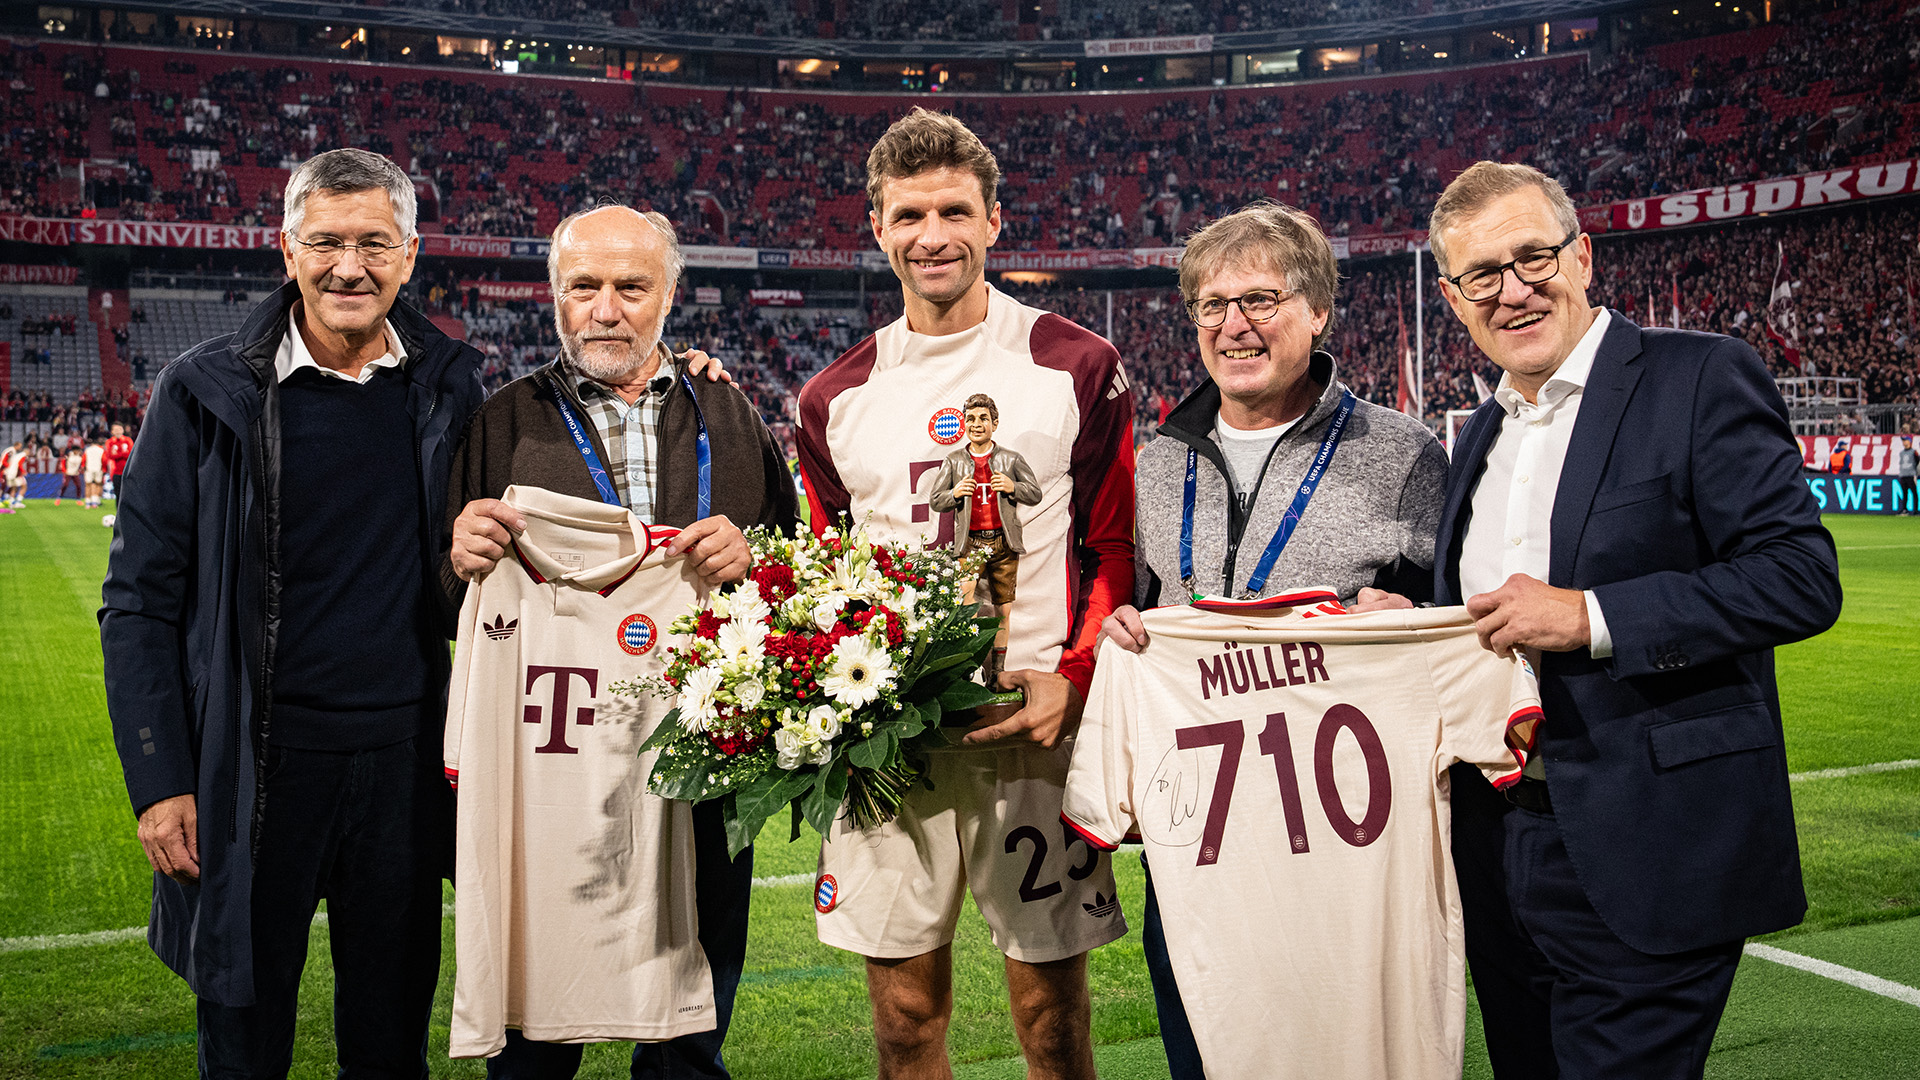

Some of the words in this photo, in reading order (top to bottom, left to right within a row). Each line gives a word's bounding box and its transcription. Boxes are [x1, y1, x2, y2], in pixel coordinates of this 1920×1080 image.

[1660, 159, 1920, 226] SÜDKU
[450, 237, 511, 257] Preying
[572, 430, 585, 445] UEFA
[1308, 460, 1322, 482] UEFA
[1317, 426, 1340, 465] CHAMPIONS
[1336, 405, 1350, 429] LEAGUE
[1806, 478, 1828, 510] S
[1834, 478, 1884, 511] WE
[1892, 478, 1920, 511] N
[1197, 640, 1331, 701] MÜLLER
[523, 665, 598, 754] T
[1175, 703, 1392, 866] 710
